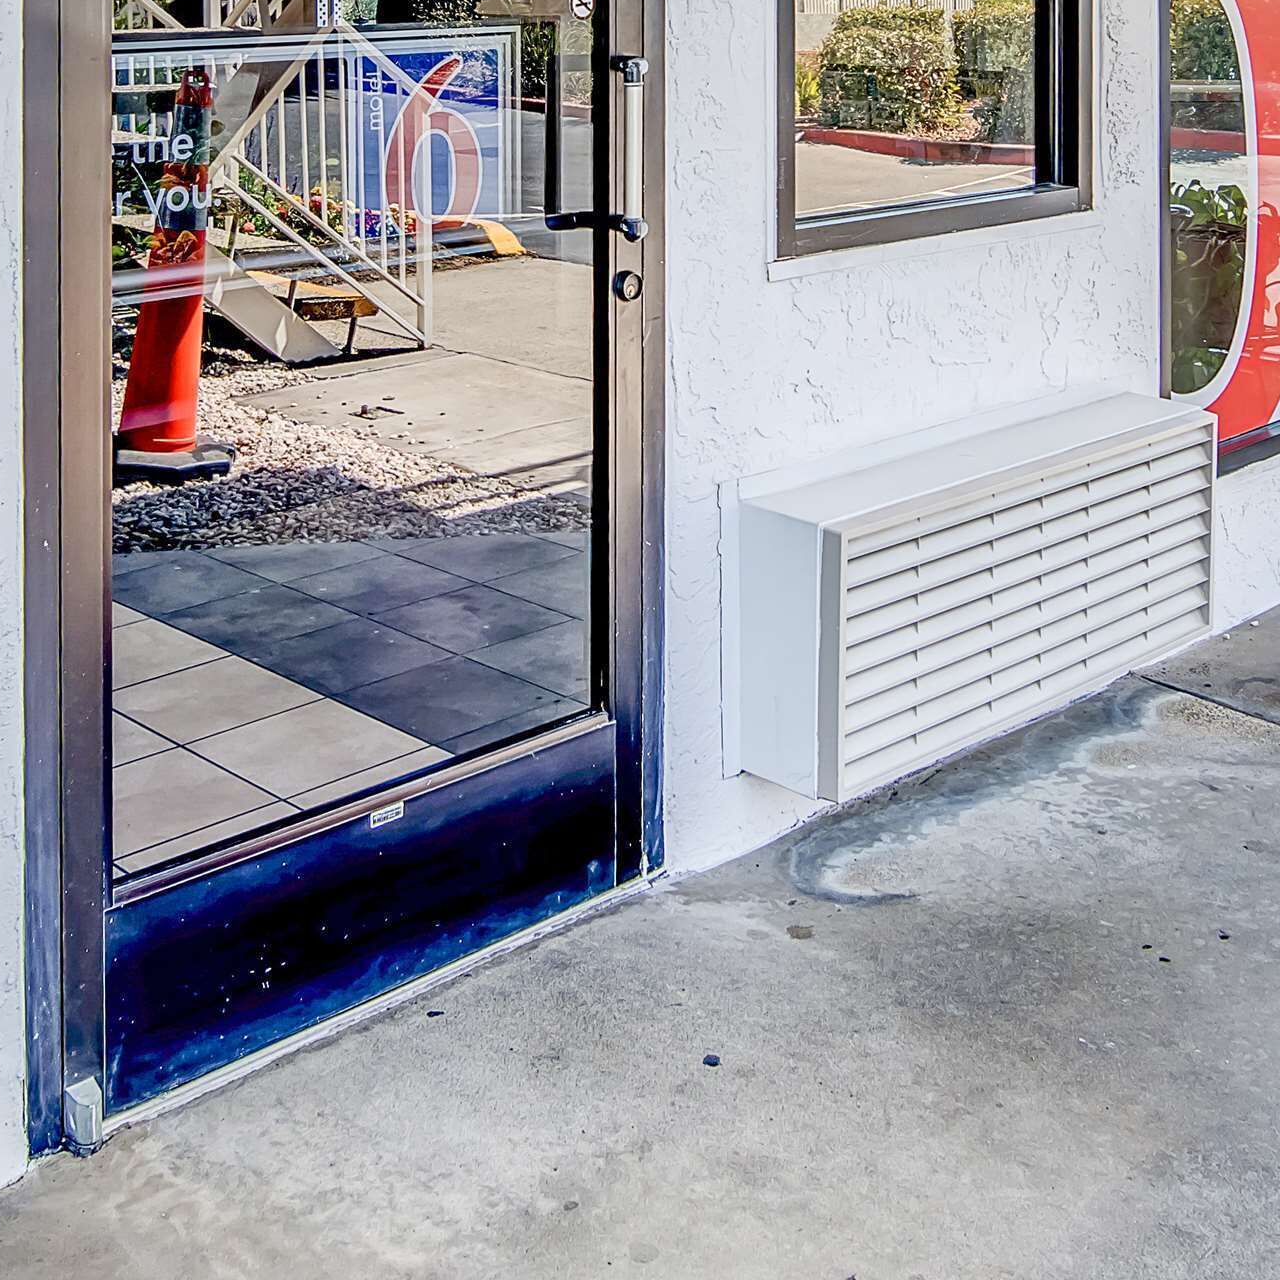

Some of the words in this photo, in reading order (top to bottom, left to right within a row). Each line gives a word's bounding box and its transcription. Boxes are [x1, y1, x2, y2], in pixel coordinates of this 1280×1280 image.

[130, 125, 194, 163] the
[370, 72, 383, 131] motel
[384, 56, 483, 235] 6
[143, 183, 222, 223] you.
